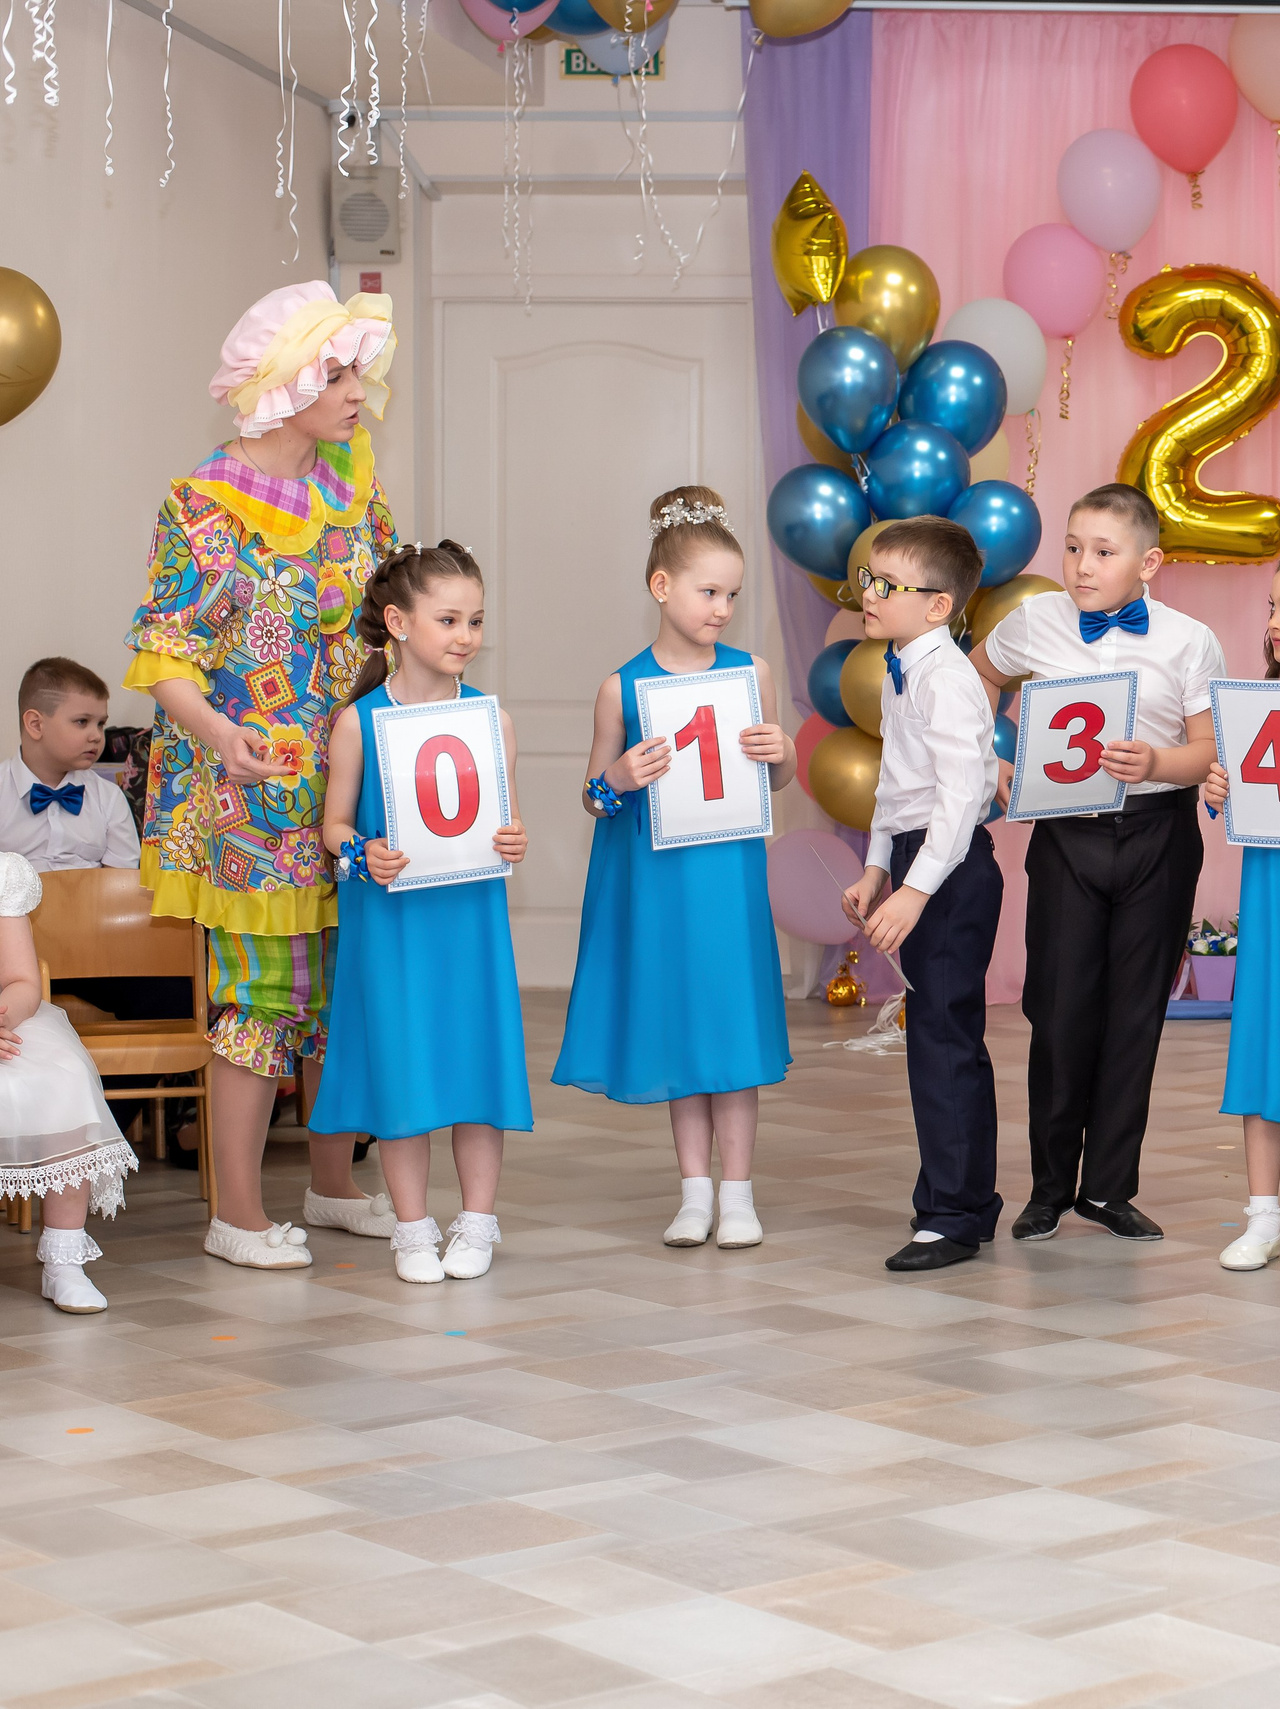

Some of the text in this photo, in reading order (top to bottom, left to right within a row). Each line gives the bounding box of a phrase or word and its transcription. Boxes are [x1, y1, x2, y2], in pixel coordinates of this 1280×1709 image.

[415, 734, 481, 838] 0
[674, 705, 725, 802] 1
[1043, 701, 1106, 785] 3
